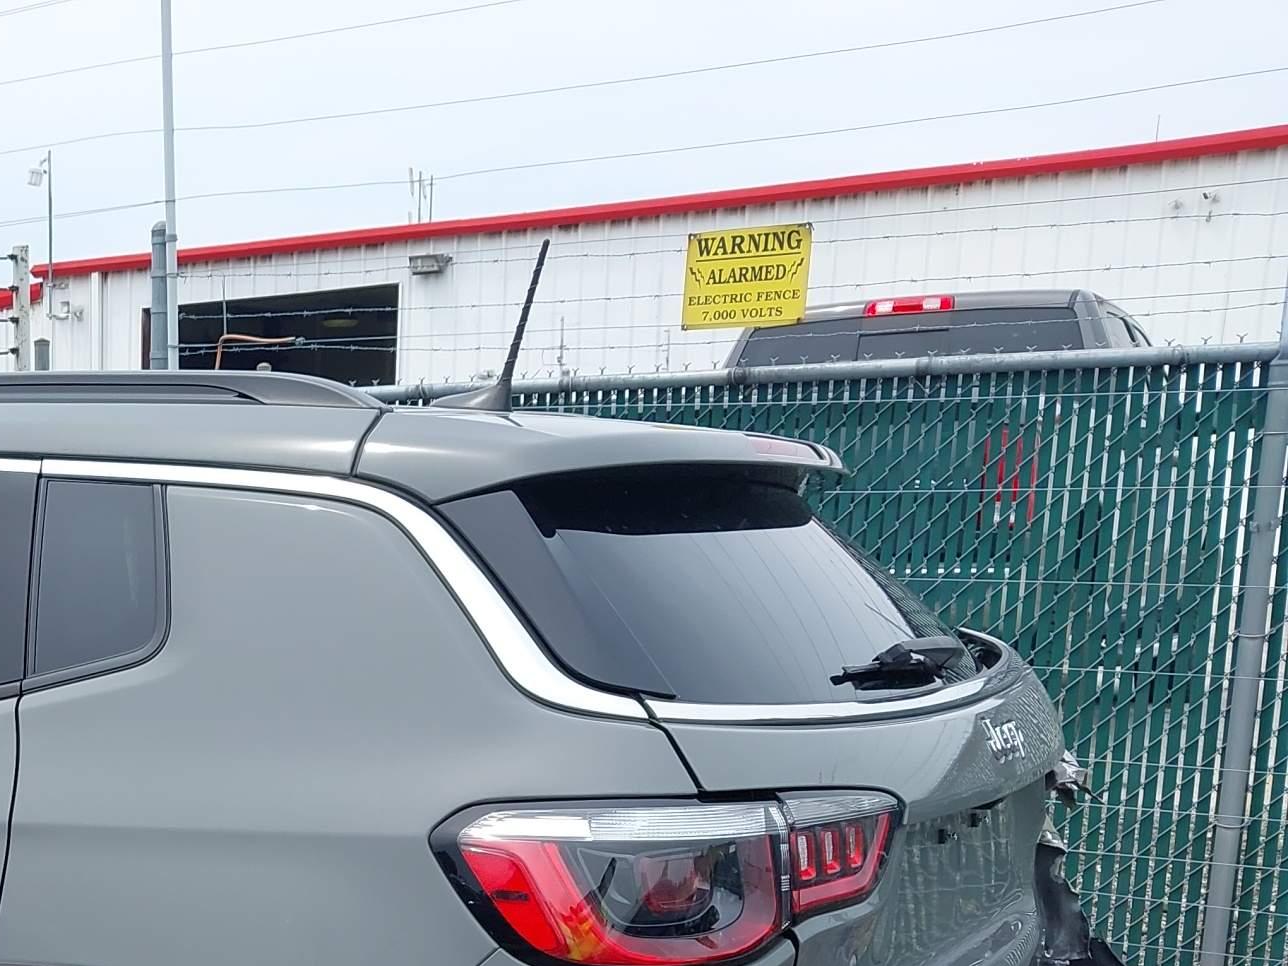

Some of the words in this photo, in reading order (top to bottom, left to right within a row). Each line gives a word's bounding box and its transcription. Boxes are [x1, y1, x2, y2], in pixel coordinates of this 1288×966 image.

[697, 230, 803, 257] WARNING
[706, 264, 786, 285] ALARMED
[688, 293, 752, 306] ELECTRIC
[757, 289, 801, 302] FENCE
[702, 309, 737, 321] 7,000
[741, 306, 783, 319] VOLTS
[982, 718, 1025, 758] Jeep
